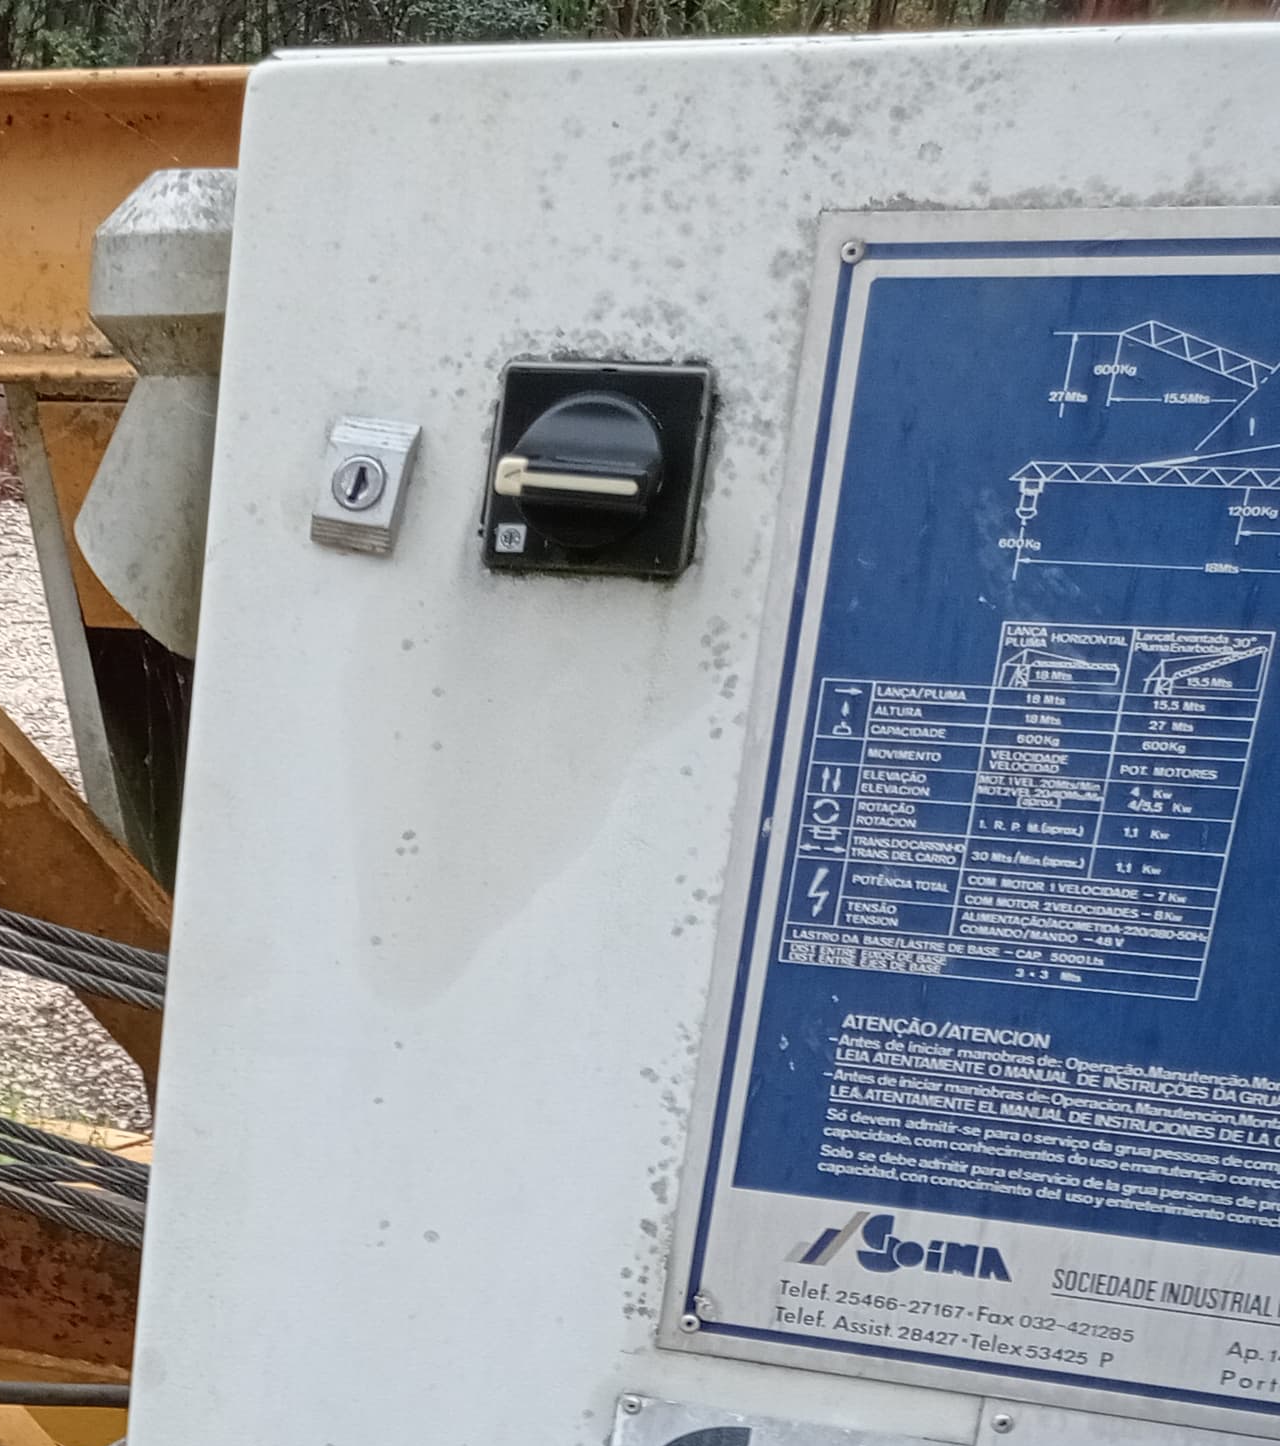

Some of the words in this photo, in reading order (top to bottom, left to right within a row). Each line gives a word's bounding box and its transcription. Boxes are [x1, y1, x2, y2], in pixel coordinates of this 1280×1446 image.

[1228, 506, 1278, 520] 1200Kg
[1051, 632, 1128, 646] HORIZONTAL
[874, 706, 922, 718] ALTURA
[870, 725, 947, 739] CAPACIDADE
[1017, 735, 1060, 747] 600Kg
[1142, 741, 1187, 753] 600Kg
[867, 748, 942, 762] MOVIMENTO
[1152, 767, 1218, 780] MOTORES
[861, 783, 931, 797] ELEVACION
[856, 815, 917, 828] ROTACION
[1001, 879, 1045, 891] MOTOR
[847, 900, 897, 914] TENSÃO
[995, 898, 1040, 910] MOTOR
[845, 913, 899, 927] TENSION
[792, 929, 840, 943] LASTRO
[842, 934, 860, 945] DA
[967, 945, 1001, 958] BASE
[885, 1037, 904, 1051] de
[907, 1040, 953, 1057] iniciar
[957, 1047, 1034, 1065] manobras
[835, 1048, 870, 1063] LEIA
[872, 1050, 985, 1075] ATENTAMENTE
[988, 1064, 1001, 1076] O
[1004, 1066, 1070, 1084] MANUAL
[1076, 1074, 1099, 1087] DE
[1103, 1075, 1209, 1099] INSTRUÇÕES
[1212, 1088, 1237, 1102] DA
[877, 1073, 897, 1086] de
[899, 1076, 942, 1092] iniciar
[944, 1081, 1024, 1101] maniobras
[864, 1088, 977, 1113] ATENTAMENTE
[978, 1100, 997, 1114] EL
[1000, 1102, 1065, 1122] MANUAL
[1068, 1110, 1091, 1124] DE
[1094, 1114, 1216, 1140] INSTRUCIONES
[1219, 1128, 1246, 1143] DE
[1247, 1131, 1270, 1146] LA
[826, 1108, 848, 1122] Só
[850, 1111, 901, 1128] devem
[905, 1117, 981, 1137] admitir-se
[984, 1128, 1020, 1144] para
[1033, 1135, 1090, 1152] serviço
[1093, 1139, 1113, 1152] da
[1115, 1143, 1151, 1158] grua
[1152, 1149, 1219, 1166] pessoas
[1221, 1154, 1243, 1168] de
[914, 1138, 948, 1150] com
[949, 1140, 1065, 1163] conhecimentos
[1068, 1152, 1088, 1165] do
[1089, 1157, 1118, 1169] uso
[820, 1144, 854, 1159] Solo
[857, 1151, 876, 1163] se
[878, 1152, 917, 1167] debe
[918, 1157, 968, 1173] admitir
[971, 1164, 1006, 1180] para
[1022, 1170, 1080, 1186] servicio
[1083, 1176, 1104, 1190] de
[1105, 1178, 1120, 1191] la
[1121, 1182, 1158, 1198] grua
[1160, 1187, 1233, 1206] personas
[1235, 1195, 1258, 1209] de
[900, 1172, 929, 1184] con
[930, 1175, 1032, 1197] conocimiento
[1035, 1187, 1061, 1201] del
[1065, 1192, 1093, 1204] uso
[1105, 1198, 1225, 1222] entretenimiento
[1052, 1268, 1158, 1302] SOCIEDADE
[1160, 1282, 1273, 1317] INDUSTRIAL
[780, 1279, 830, 1301] Telef.
[1020, 1314, 1135, 1343] 032-421285
[775, 1306, 826, 1328] Telef.
[1026, 1345, 1089, 1365] 53425
[1099, 1352, 1114, 1368] P
[1226, 1341, 1265, 1364] Ap.
